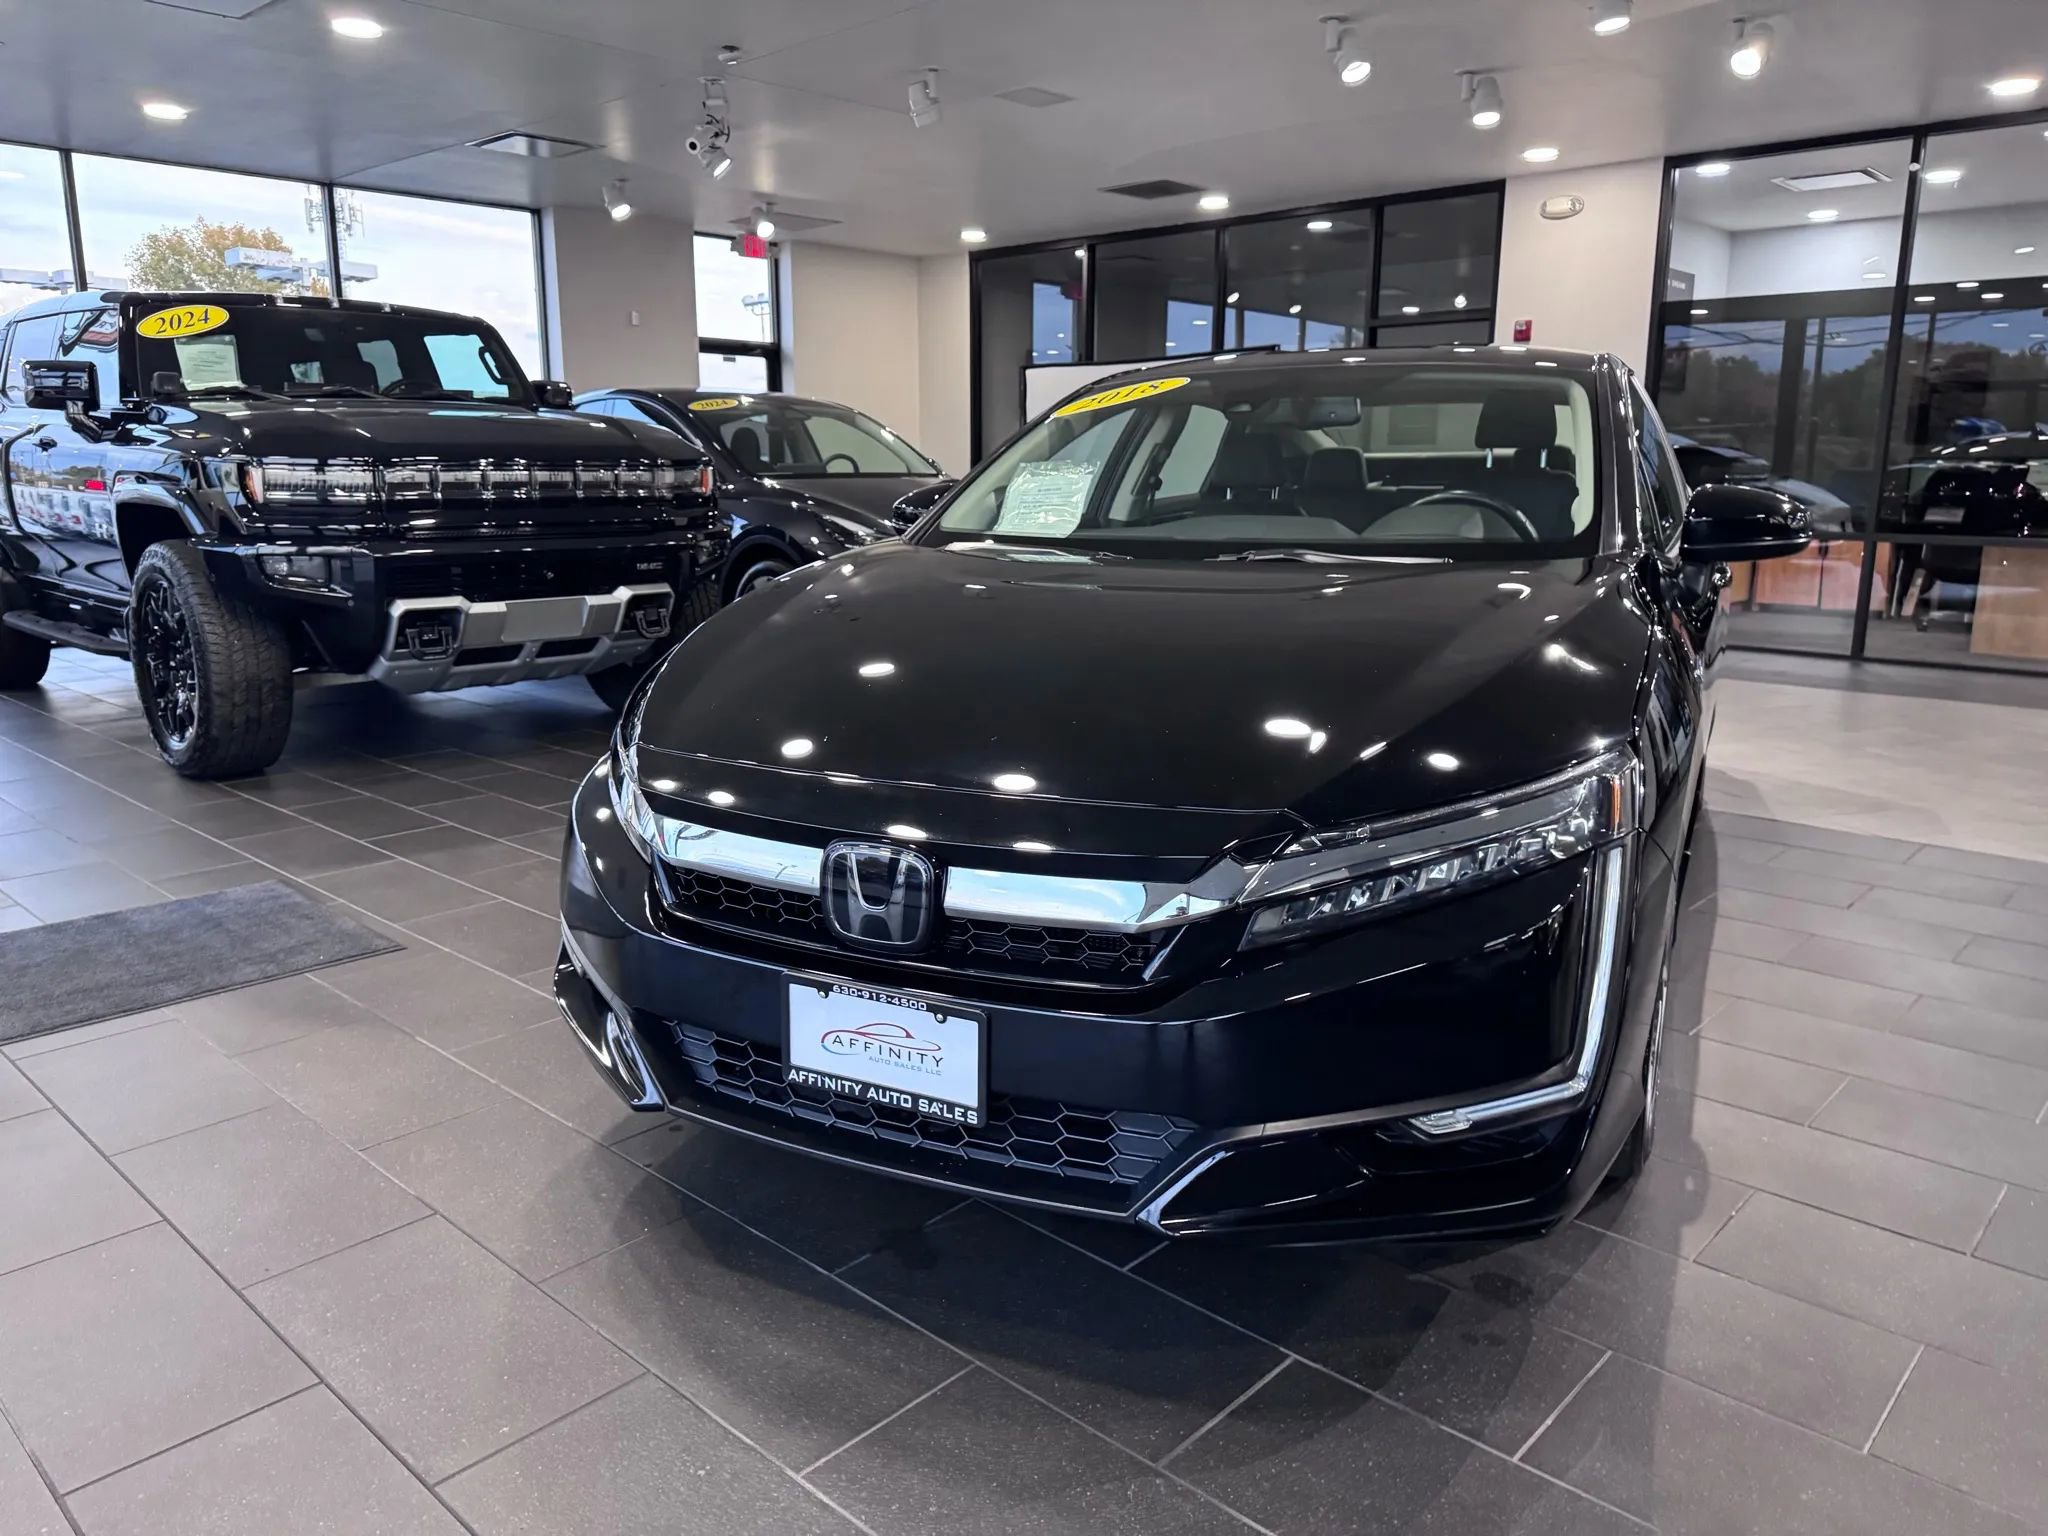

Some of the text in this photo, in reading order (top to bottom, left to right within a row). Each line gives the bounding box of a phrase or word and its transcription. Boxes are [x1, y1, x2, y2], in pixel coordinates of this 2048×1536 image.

[154, 308, 210, 334] 2024
[1072, 381, 1165, 411] 2018
[832, 1034, 944, 1068] AFFINITY
[868, 1056, 942, 1076] AUTO SALES LLC
[788, 1069, 978, 1125] AFFINITY AUTO SALES
